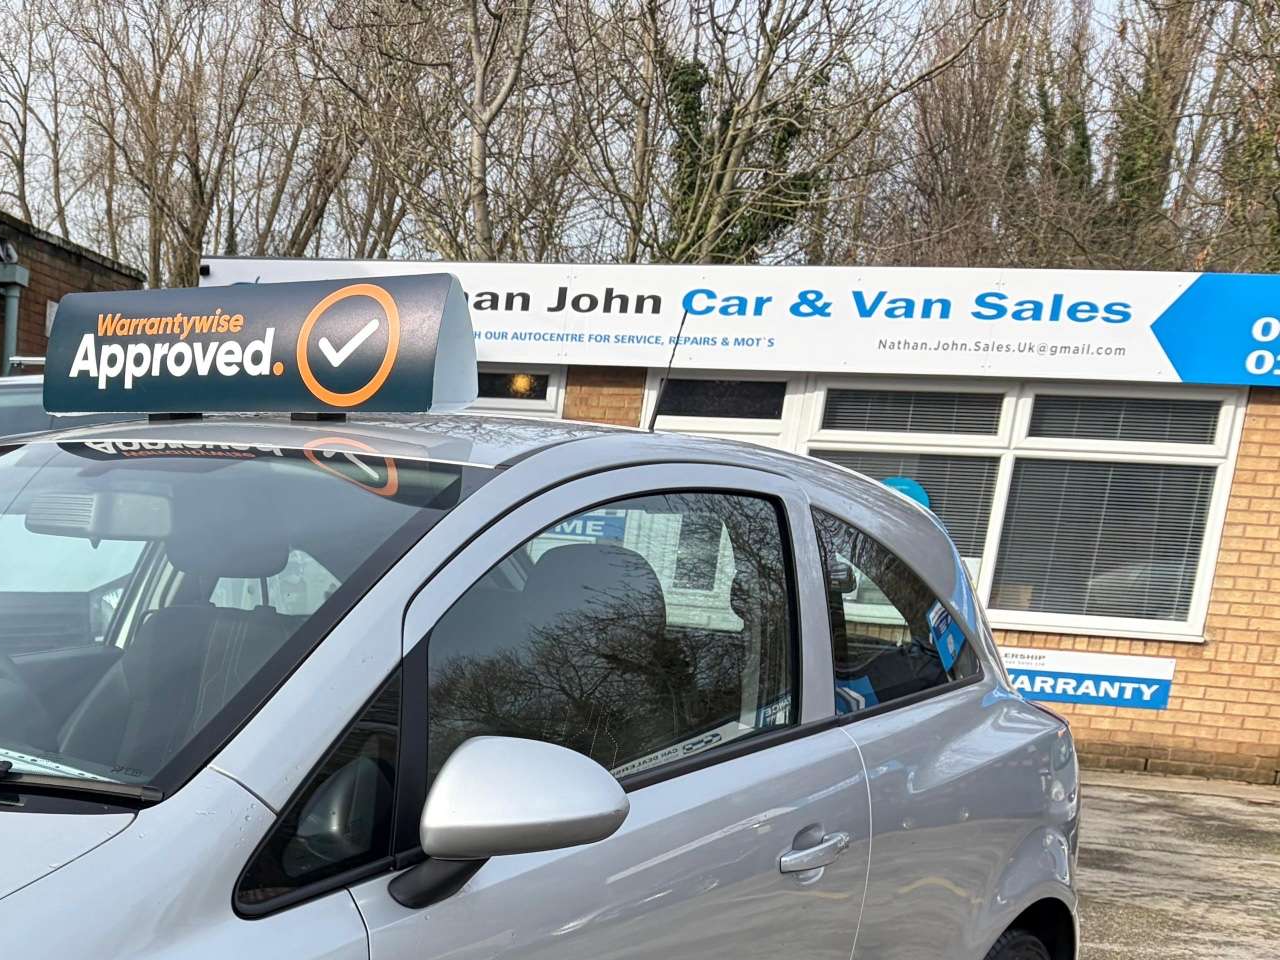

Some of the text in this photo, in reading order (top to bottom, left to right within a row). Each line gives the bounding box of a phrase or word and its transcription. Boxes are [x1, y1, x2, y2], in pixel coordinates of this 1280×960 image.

[547, 286, 662, 315] John
[681, 288, 773, 317] Car
[789, 289, 833, 318] &
[851, 290, 952, 320] Van
[970, 290, 1133, 324] Sales
[96, 308, 246, 340] Warrantywise
[484, 331, 508, 341] OUR
[511, 332, 585, 343] AUTOCENTRE
[588, 334, 610, 344] FOR
[613, 334, 665, 346] SERVICE,
[668, 336, 718, 347] REPAIRS
[721, 337, 729, 347] &
[68, 327, 285, 390] Approved.
[877, 339, 1127, 357] Nathan.John.Sales.Uk@gmail.com
